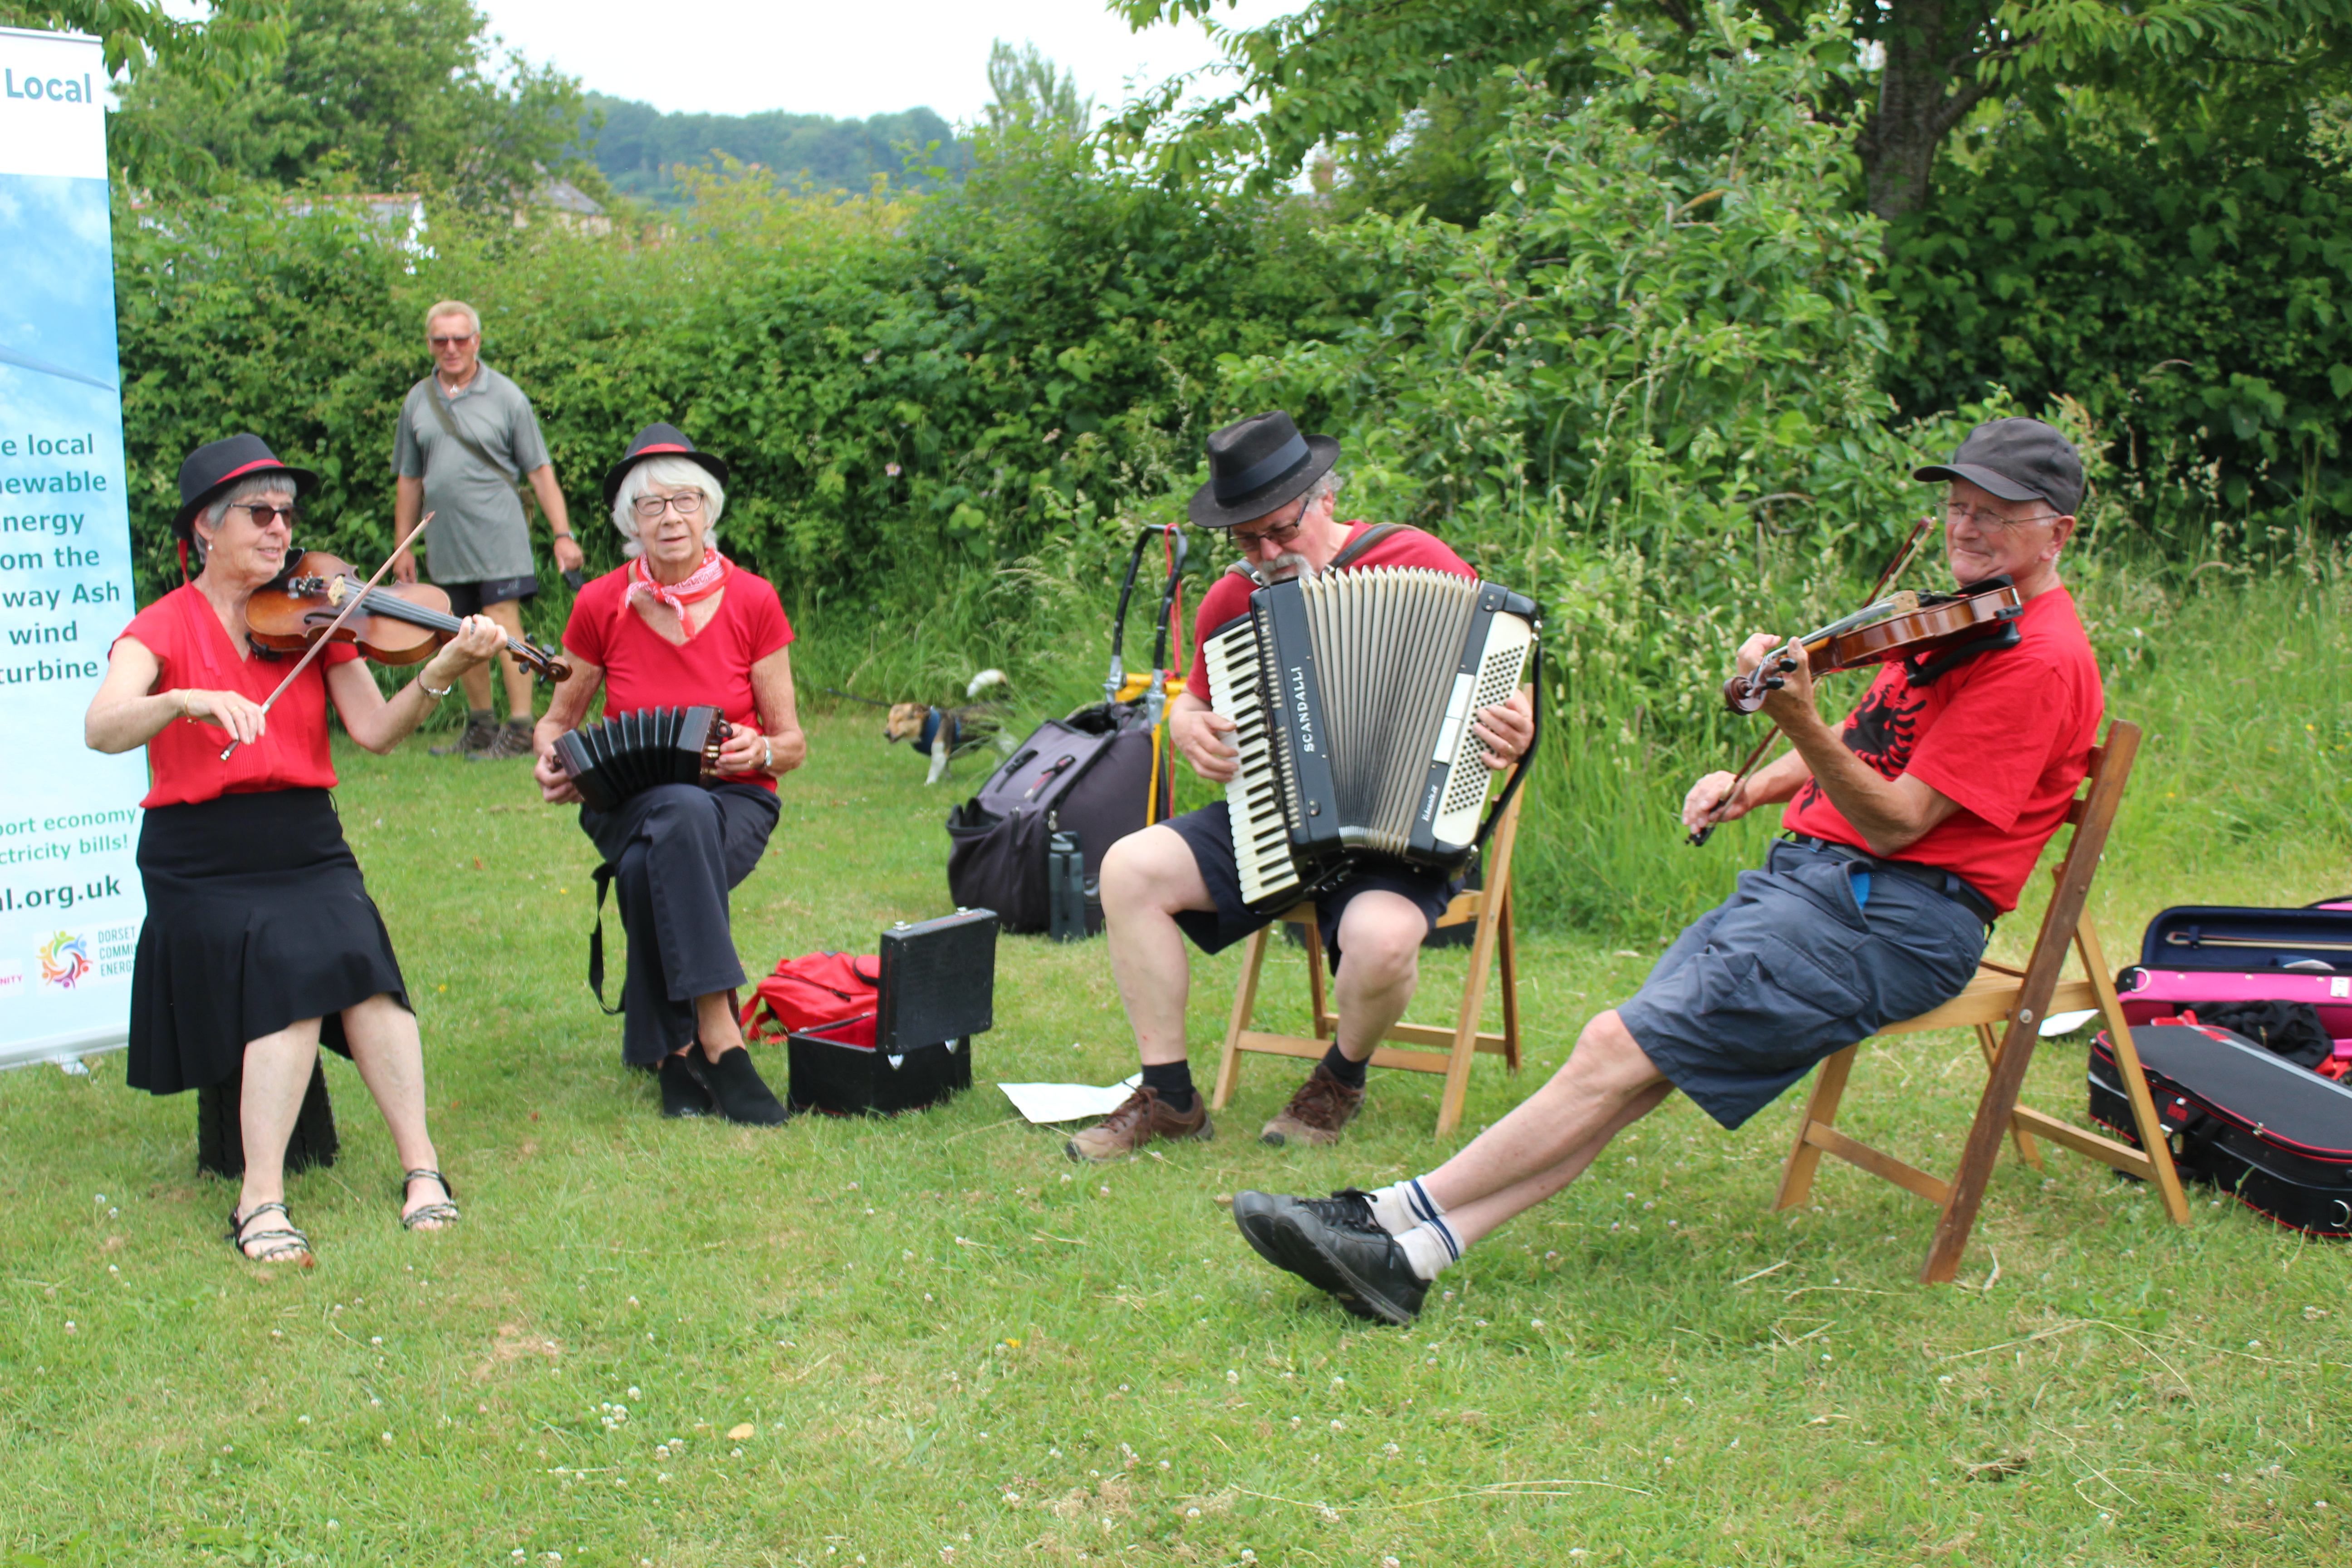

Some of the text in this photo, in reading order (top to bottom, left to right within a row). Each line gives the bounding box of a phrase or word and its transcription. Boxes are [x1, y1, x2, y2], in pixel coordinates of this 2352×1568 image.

[5, 68, 91, 103] Local
[28, 433, 93, 455] local
[0, 514, 84, 535] nergy
[54, 546, 99, 567] the
[72, 581, 119, 603] Ash
[9, 620, 77, 645] wind
[1290, 666, 1315, 752] SCANDALLI
[44, 808, 136, 830] economy
[80, 833, 127, 854] bills!
[98, 926, 135, 943] DORSET
[100, 959, 135, 976] ENERG
